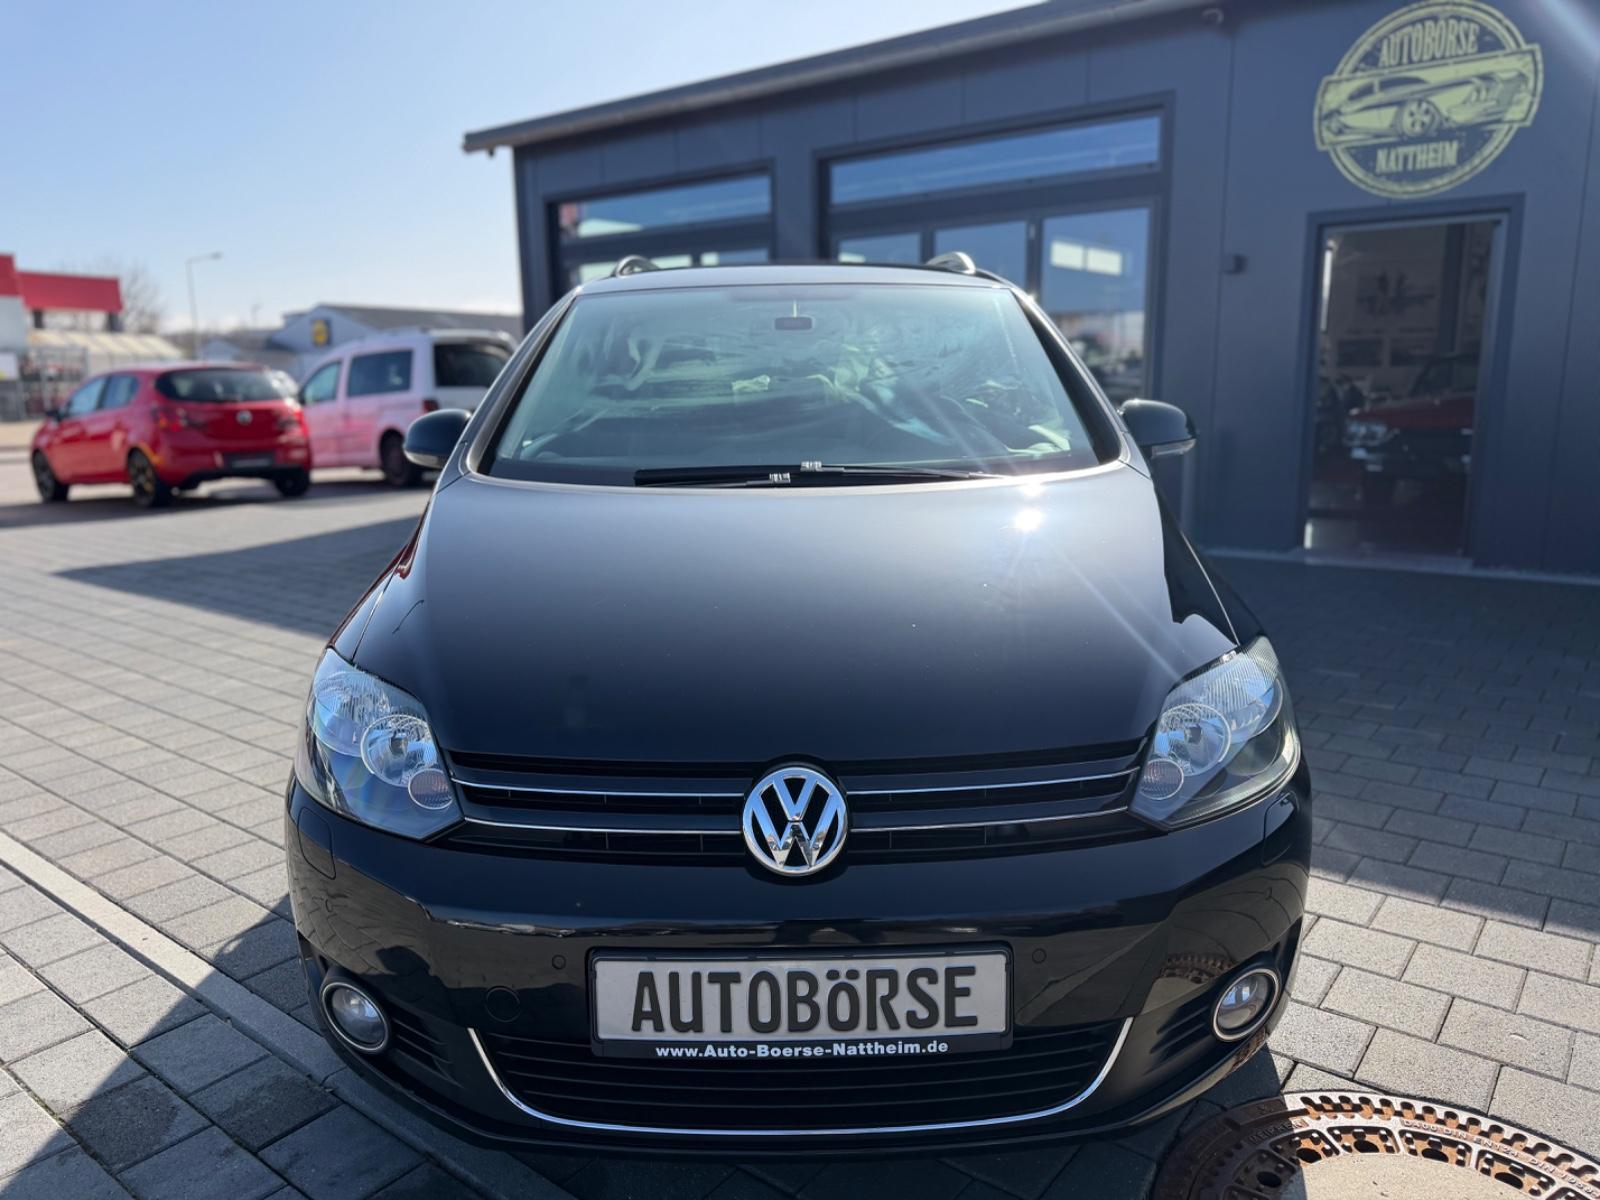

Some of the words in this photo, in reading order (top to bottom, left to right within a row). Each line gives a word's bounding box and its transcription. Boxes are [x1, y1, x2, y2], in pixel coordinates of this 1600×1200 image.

[1376, 140, 1458, 174] NATTHEIM
[631, 965, 979, 1033] AUTOBÖRSE
[656, 1040, 949, 1058] www.Auto-Boerse-Nattheim.de
